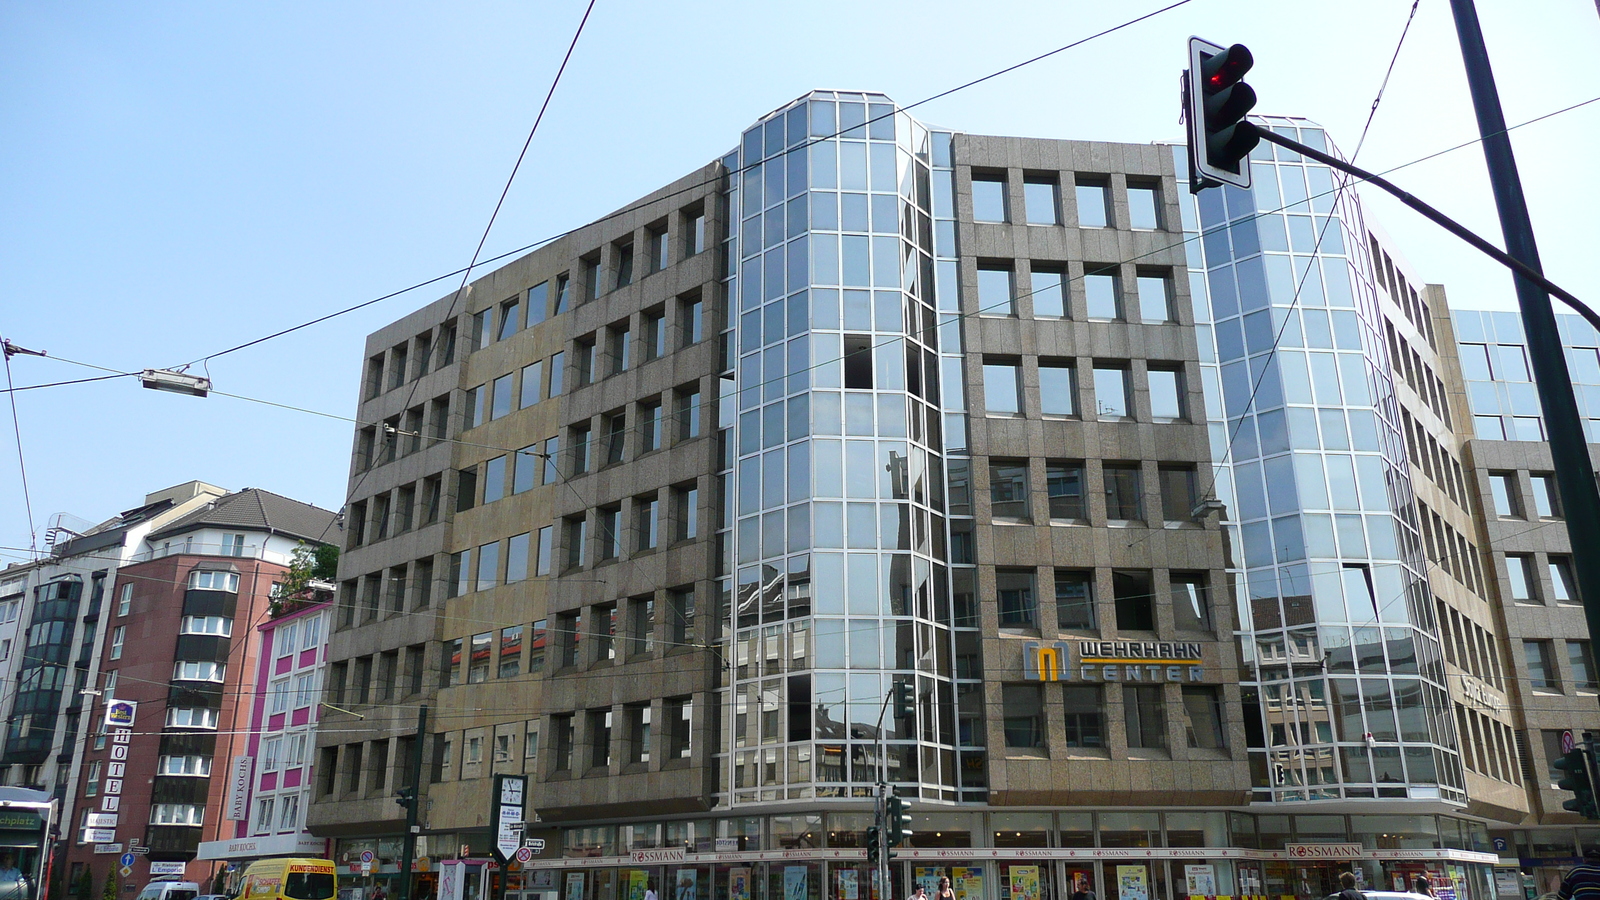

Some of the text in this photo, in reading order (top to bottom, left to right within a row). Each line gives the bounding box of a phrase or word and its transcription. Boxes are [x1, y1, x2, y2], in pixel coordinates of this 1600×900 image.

[1079, 641, 1202, 659] WEHRHAHN
[1080, 664, 1204, 681] CENTER
[106, 730, 128, 810] HOTEL
[233, 794, 243, 818] BABY
[632, 851, 684, 863] ROSSMANN
[1288, 846, 1361, 858] ROSSMANN
[290, 865, 334, 873] KUNDENDIENST
